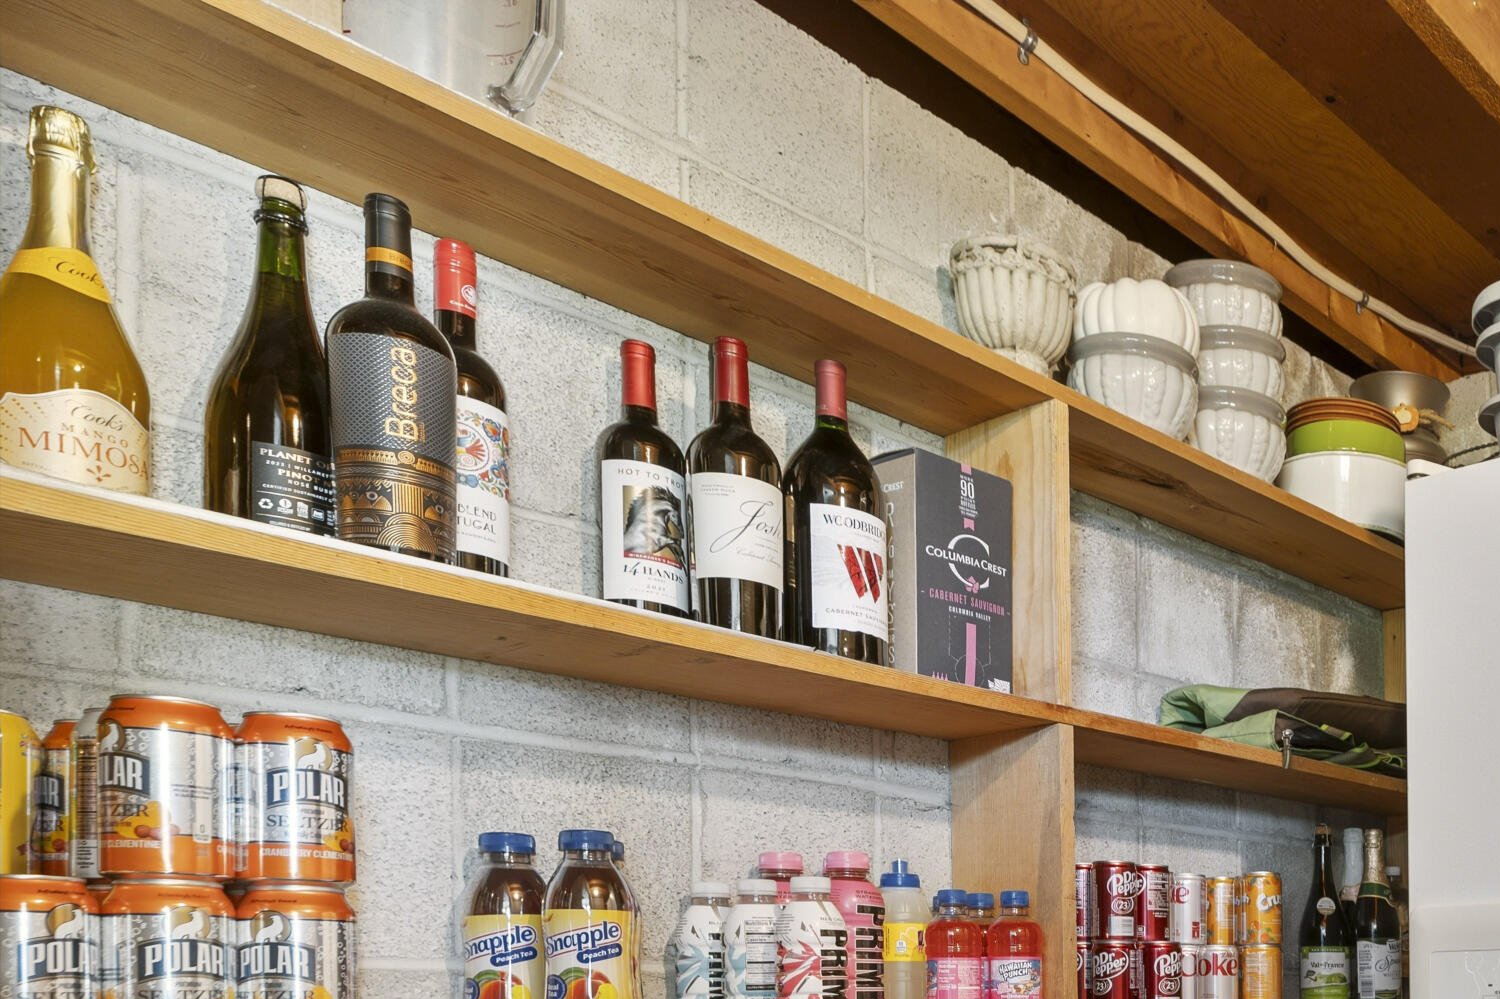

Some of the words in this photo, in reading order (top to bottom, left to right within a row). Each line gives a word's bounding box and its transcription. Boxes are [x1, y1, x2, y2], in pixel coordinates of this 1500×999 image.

[384, 346, 419, 442] Breca
[61, 422, 129, 448] MANGO
[18, 427, 149, 480] MIMOSA
[260, 447, 313, 465] PLANET
[617, 468, 641, 476] HOT
[646, 471, 660, 481] TO
[960, 480, 975, 499] 90
[457, 503, 497, 521] BLEND
[925, 545, 981, 568] COLUMBIA
[980, 559, 1008, 578] CREST
[643, 566, 684, 585] HANDS
[929, 587, 968, 606] CABERNET
[970, 597, 1005, 617] SAUVIGNON
[272, 770, 345, 808] POLAR
[545, 920, 620, 956] Snapple
[144, 942, 225, 977] POLAR
[240, 944, 310, 979] POLAR
[519, 949, 534, 960] Tea
[582, 949, 607, 961] Peach
[606, 946, 620, 957] Tea
[1099, 951, 1116, 963] Dr
[999, 961, 1033, 975] HAWAIIAN
[1002, 968, 1029, 981] PUNCH
[1158, 954, 1182, 976] Pepp
